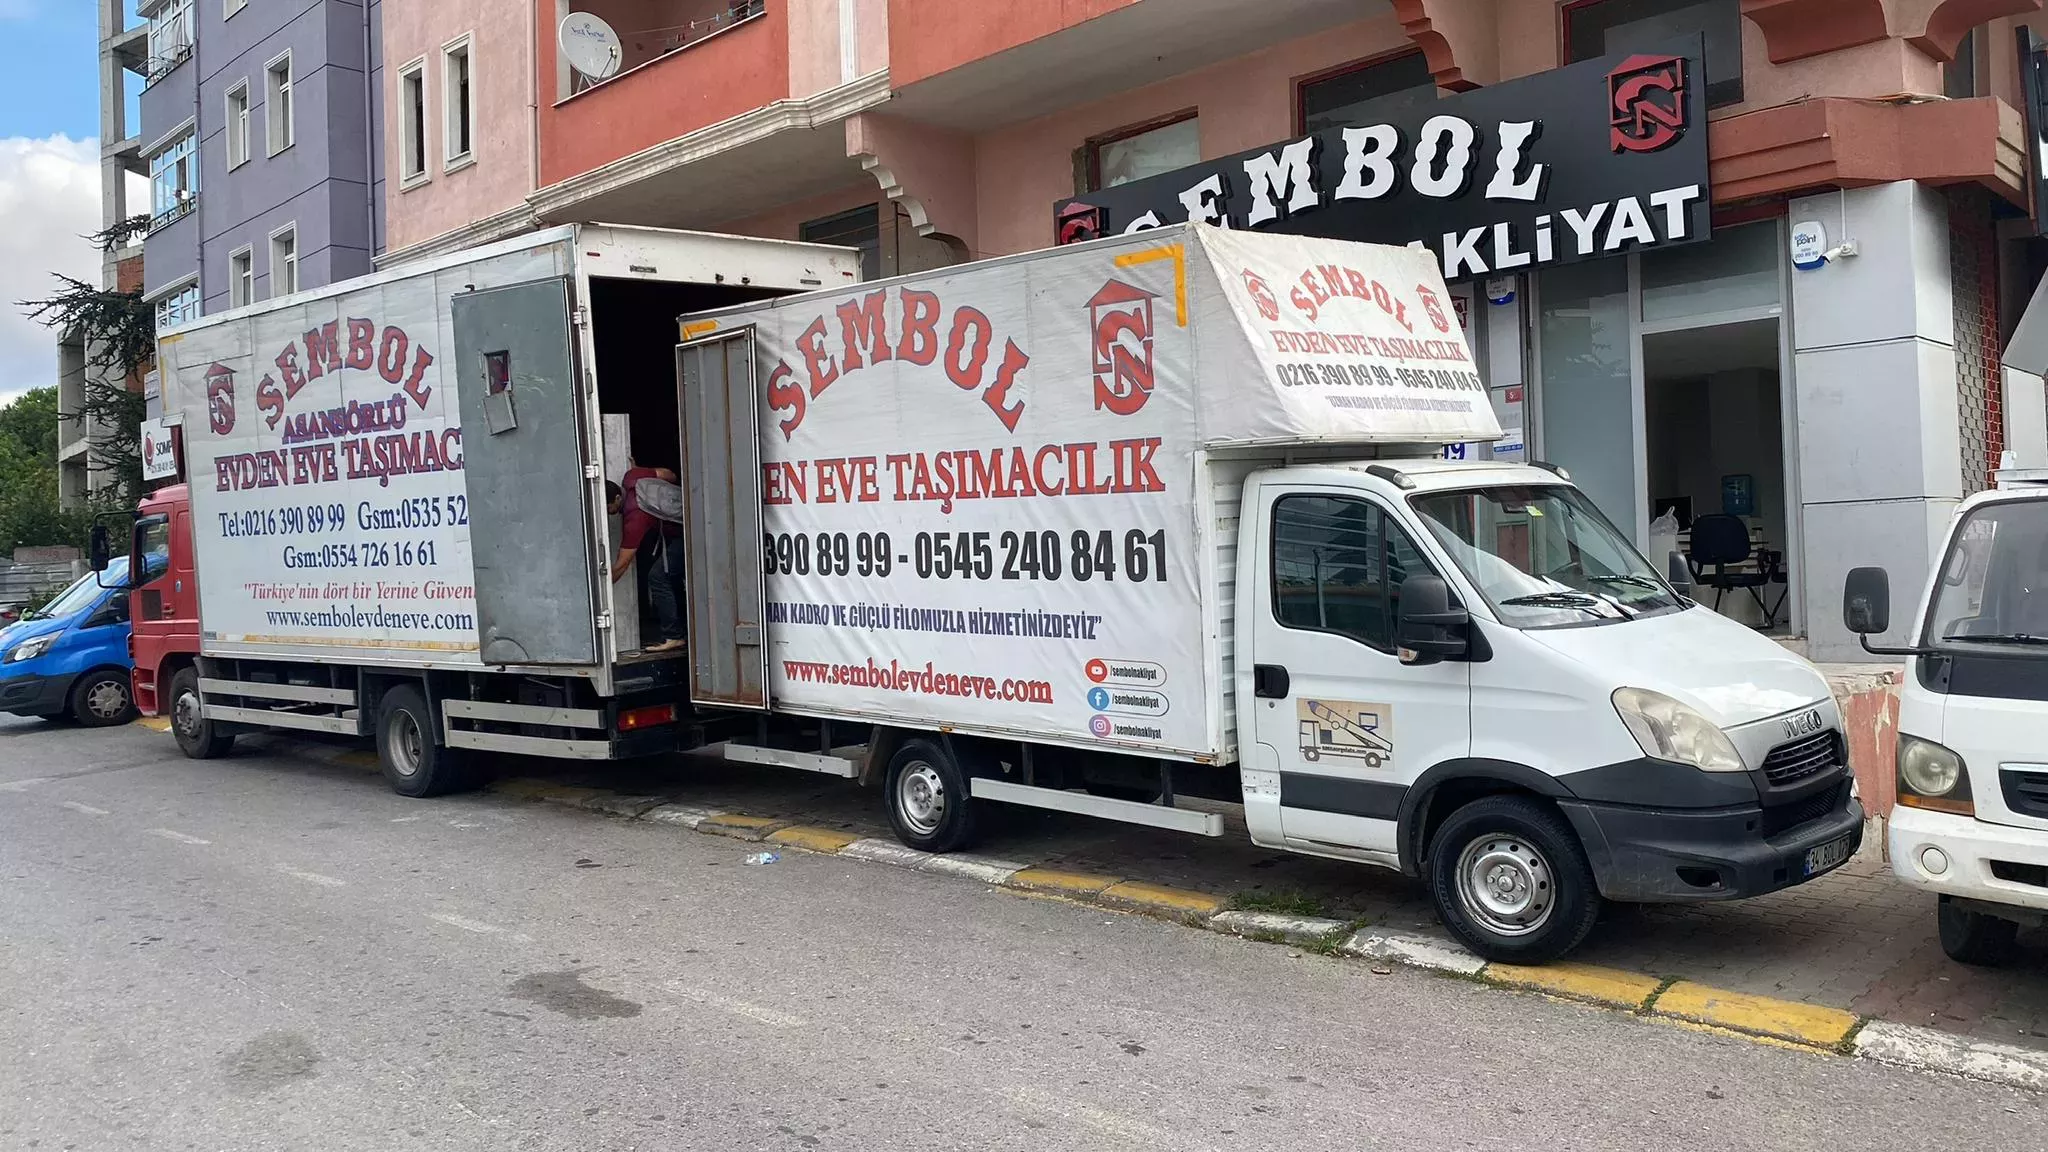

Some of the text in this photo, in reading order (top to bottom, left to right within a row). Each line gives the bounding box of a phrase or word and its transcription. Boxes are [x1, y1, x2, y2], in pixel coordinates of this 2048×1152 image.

[1291, 264, 1414, 334] SEMBOL
[767, 285, 1030, 441] SEMBOL
[1269, 330, 1469, 364] EVDEN EVE TAŞIMACILIK
[255, 316, 434, 431] SEMBOL
[1276, 363, 1319, 387] 0216
[1317, 363, 1352, 387] 390
[1349, 364, 1373, 387] 89
[1370, 365, 1394, 387] 99
[1396, 367, 1433, 390] 0545
[1429, 369, 1456, 391] 240
[1452, 370, 1473, 391] 84
[1468, 371, 1482, 392] 6
[281, 392, 407, 444] ASANSÖRLÜ
[214, 427, 464, 492] EVDEN EVE TAŞIMAC
[814, 456, 880, 504] EVE
[886, 437, 1167, 514] TAŞIMACILIK
[219, 503, 346, 537] Tel:0216 390 89 99
[357, 497, 442, 530] Gsm:0535
[283, 540, 438, 568] Gsm:0554 726 16 61
[765, 532, 810, 575] 390
[816, 532, 850, 577] 89
[856, 532, 891, 578] 99
[915, 531, 993, 580] 0545
[1000, 529, 1063, 581] 240
[1071, 529, 1116, 582] 84
[1125, 528, 1168, 583] 61
[322, 582, 349, 600] dört
[352, 581, 372, 600] bir
[376, 581, 418, 600] Yerine
[266, 604, 474, 630] www.sembolevdeneve.com
[790, 602, 830, 626] KADRO
[832, 604, 848, 627] VE
[849, 602, 891, 632] GÜÇLÜ
[894, 604, 966, 634] FİLOMUZLA
[783, 657, 1054, 704] www.sembolevdeneve.com
[1781, 708, 1823, 740] IVECO
